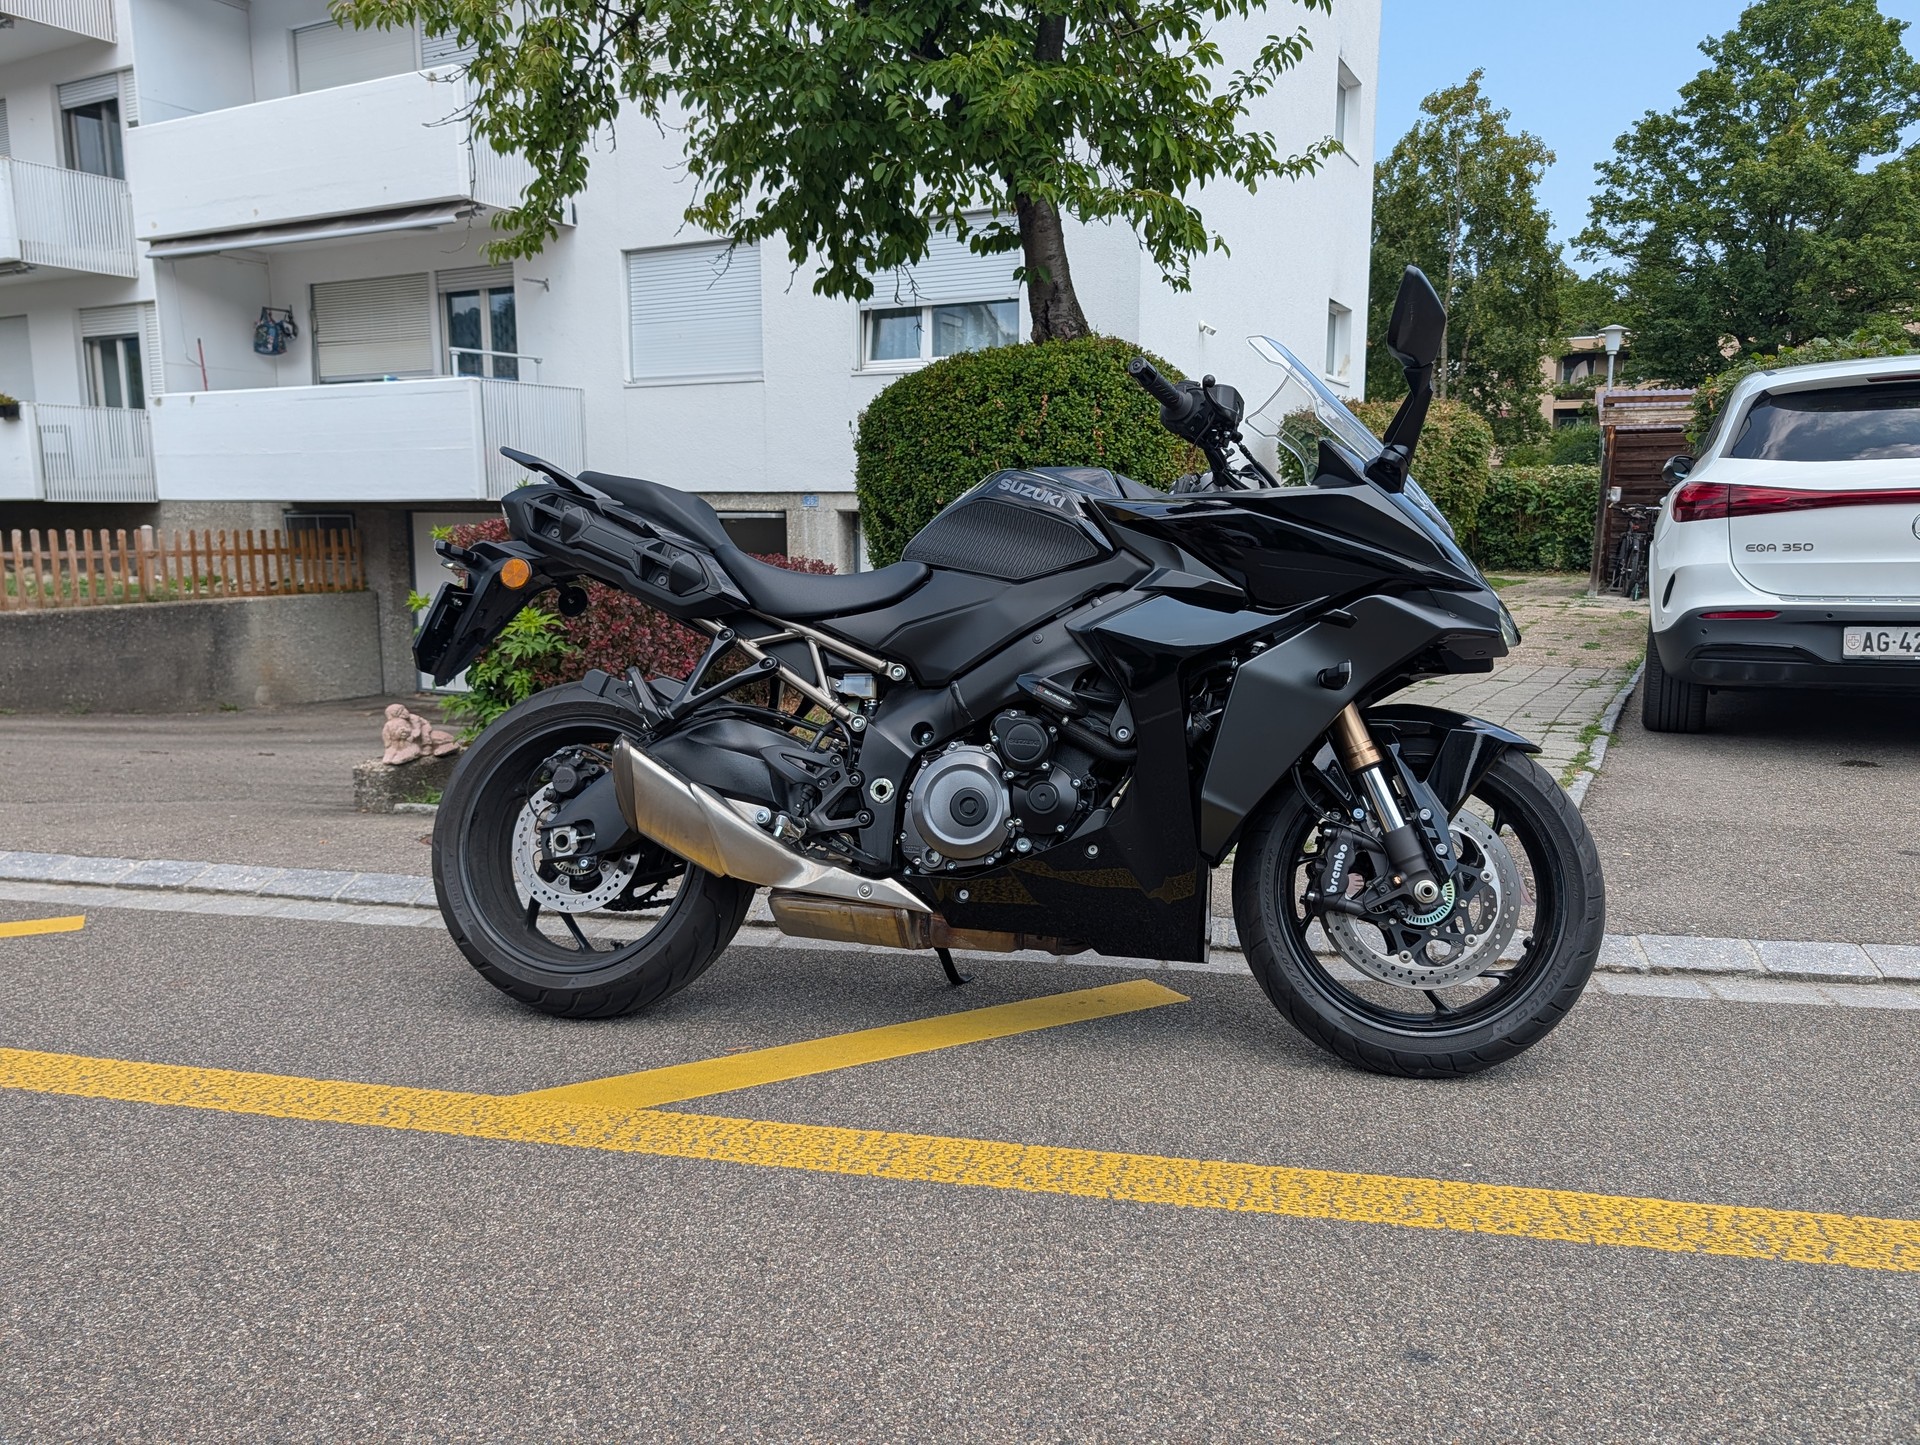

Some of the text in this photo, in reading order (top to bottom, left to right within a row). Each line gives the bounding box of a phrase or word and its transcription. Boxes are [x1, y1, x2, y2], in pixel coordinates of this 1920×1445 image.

[998, 478, 1067, 508] SUZUKI
[1745, 542, 1814, 553] EQA 350
[1326, 844, 1348, 893] brembo
